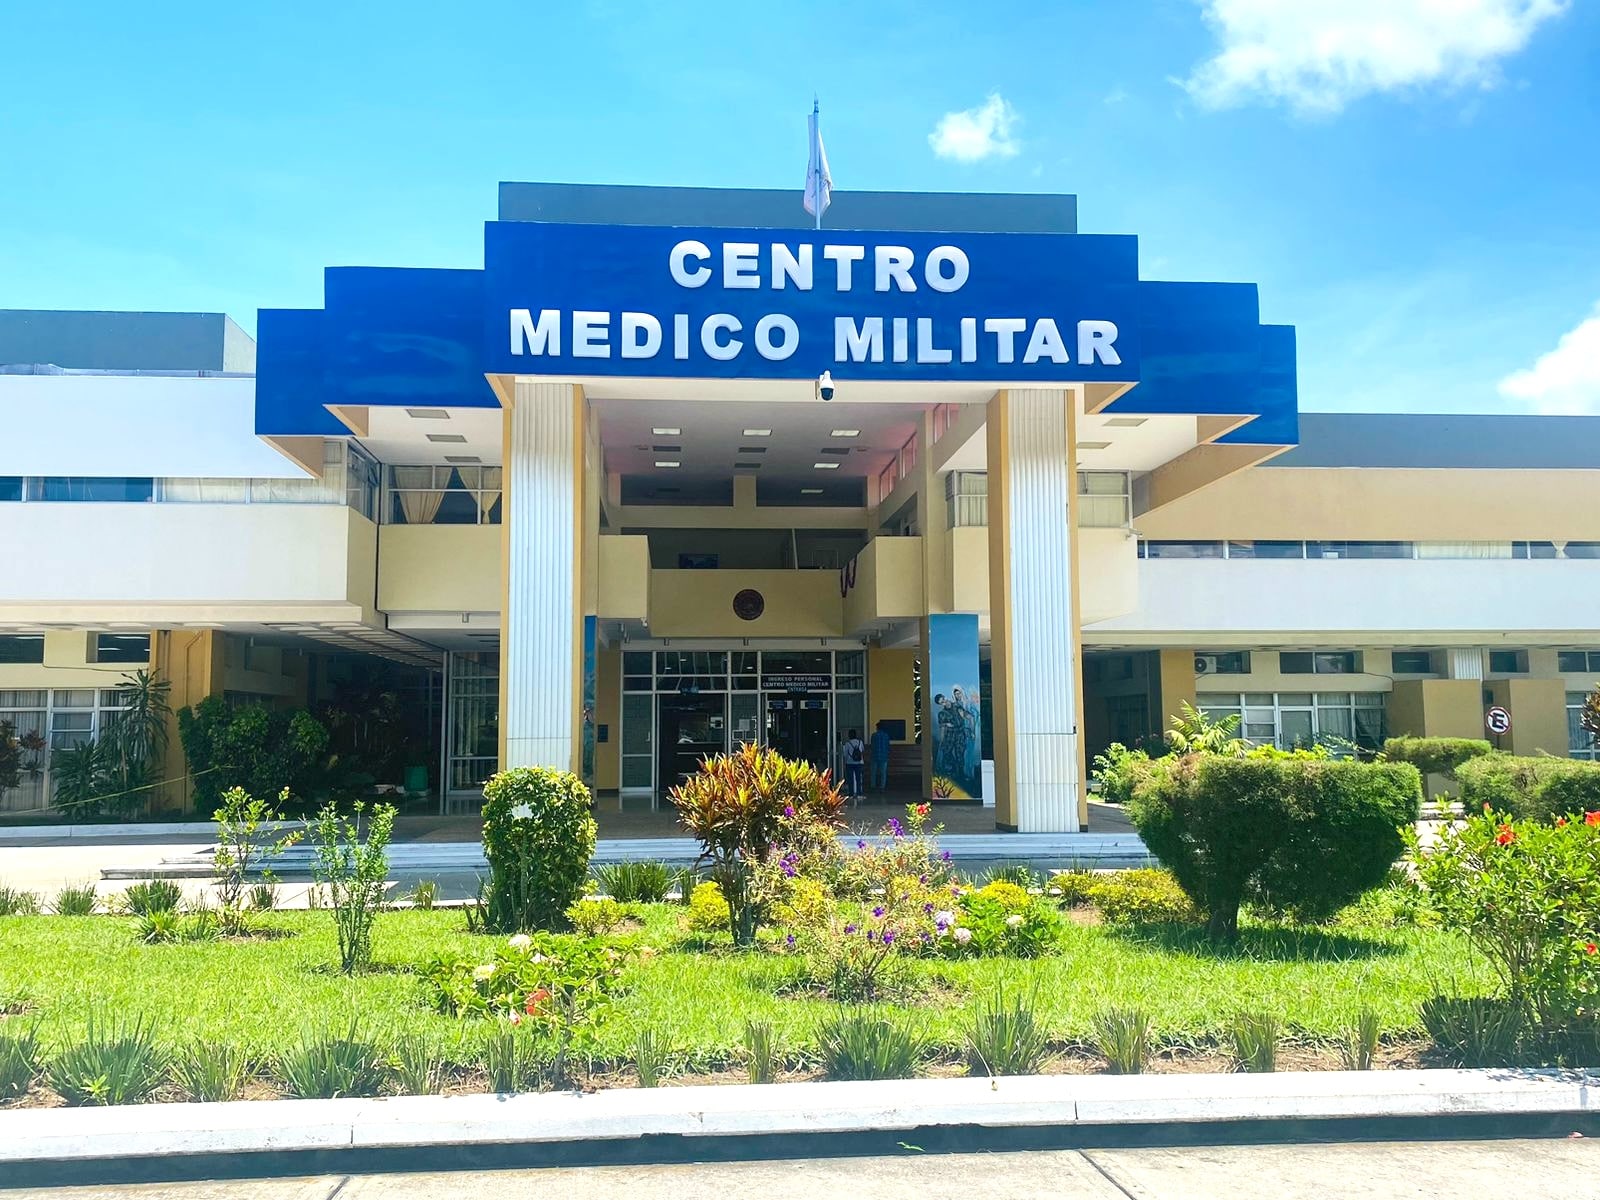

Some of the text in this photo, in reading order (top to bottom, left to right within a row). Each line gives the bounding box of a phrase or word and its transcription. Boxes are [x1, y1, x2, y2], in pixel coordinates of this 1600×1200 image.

[669, 240, 970, 293] CENTRO
[509, 308, 1122, 366] MEDICO MILITAR
[1492, 713, 1504, 729] E
